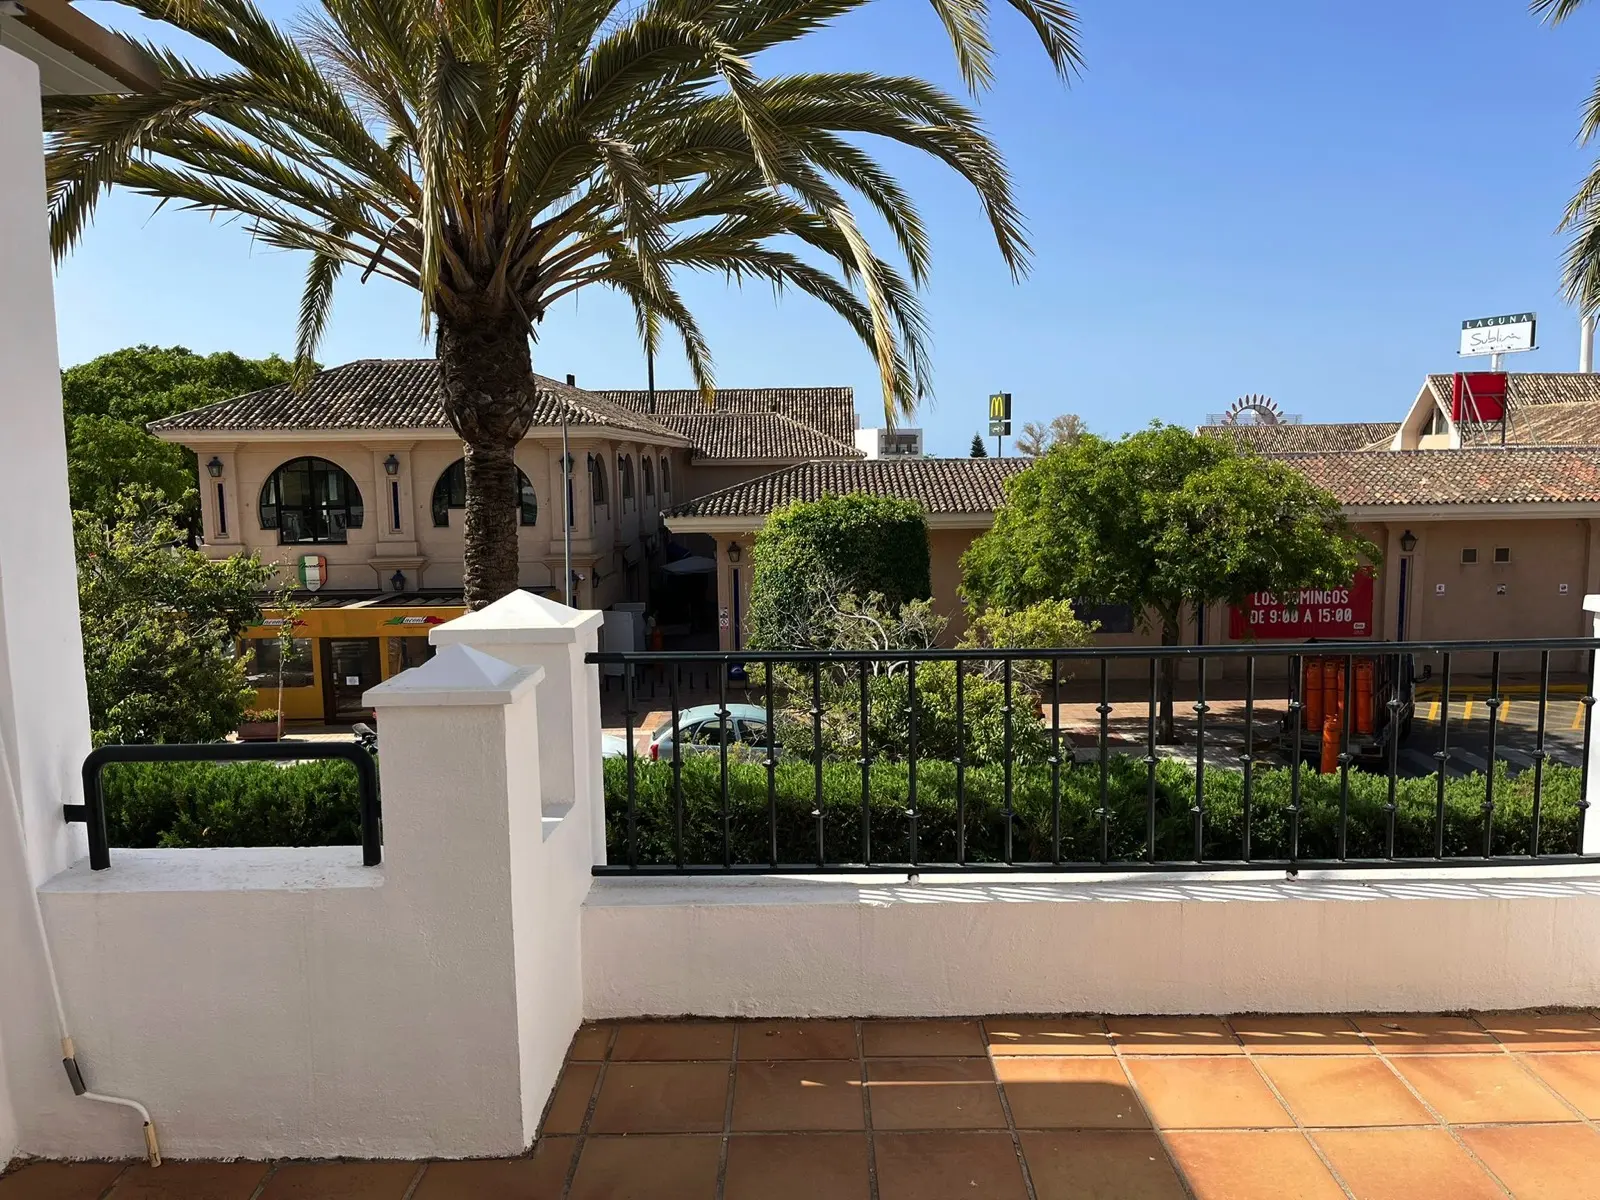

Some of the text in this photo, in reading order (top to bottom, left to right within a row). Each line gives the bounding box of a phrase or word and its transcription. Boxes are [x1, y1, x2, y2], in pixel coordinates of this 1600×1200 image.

[1466, 314, 1528, 329] LAGUNA
[1254, 591, 1278, 606] LOS
[1250, 608, 1353, 624] DE 9:00 A 15:00
